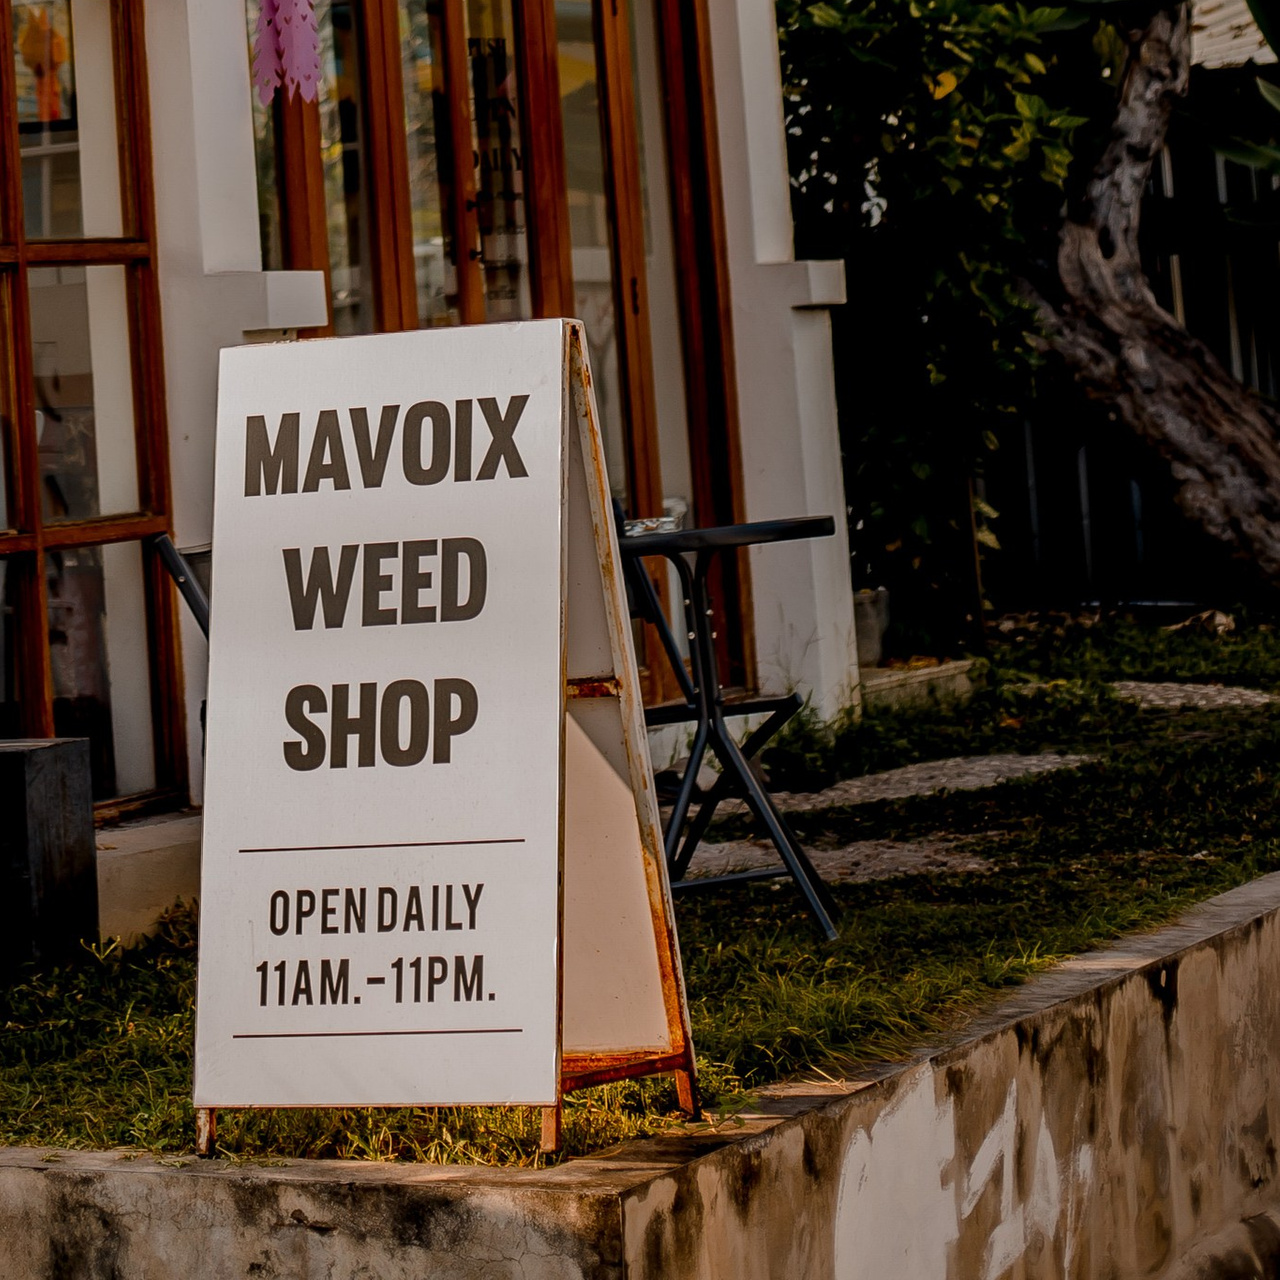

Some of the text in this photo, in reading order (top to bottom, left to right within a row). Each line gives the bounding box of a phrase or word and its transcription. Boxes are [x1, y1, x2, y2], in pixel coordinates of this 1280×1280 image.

[244, 394, 531, 498] MAVOIX
[282, 537, 488, 632] WEED
[283, 677, 479, 772] SHOP
[269, 883, 485, 936] OPEN DAILY
